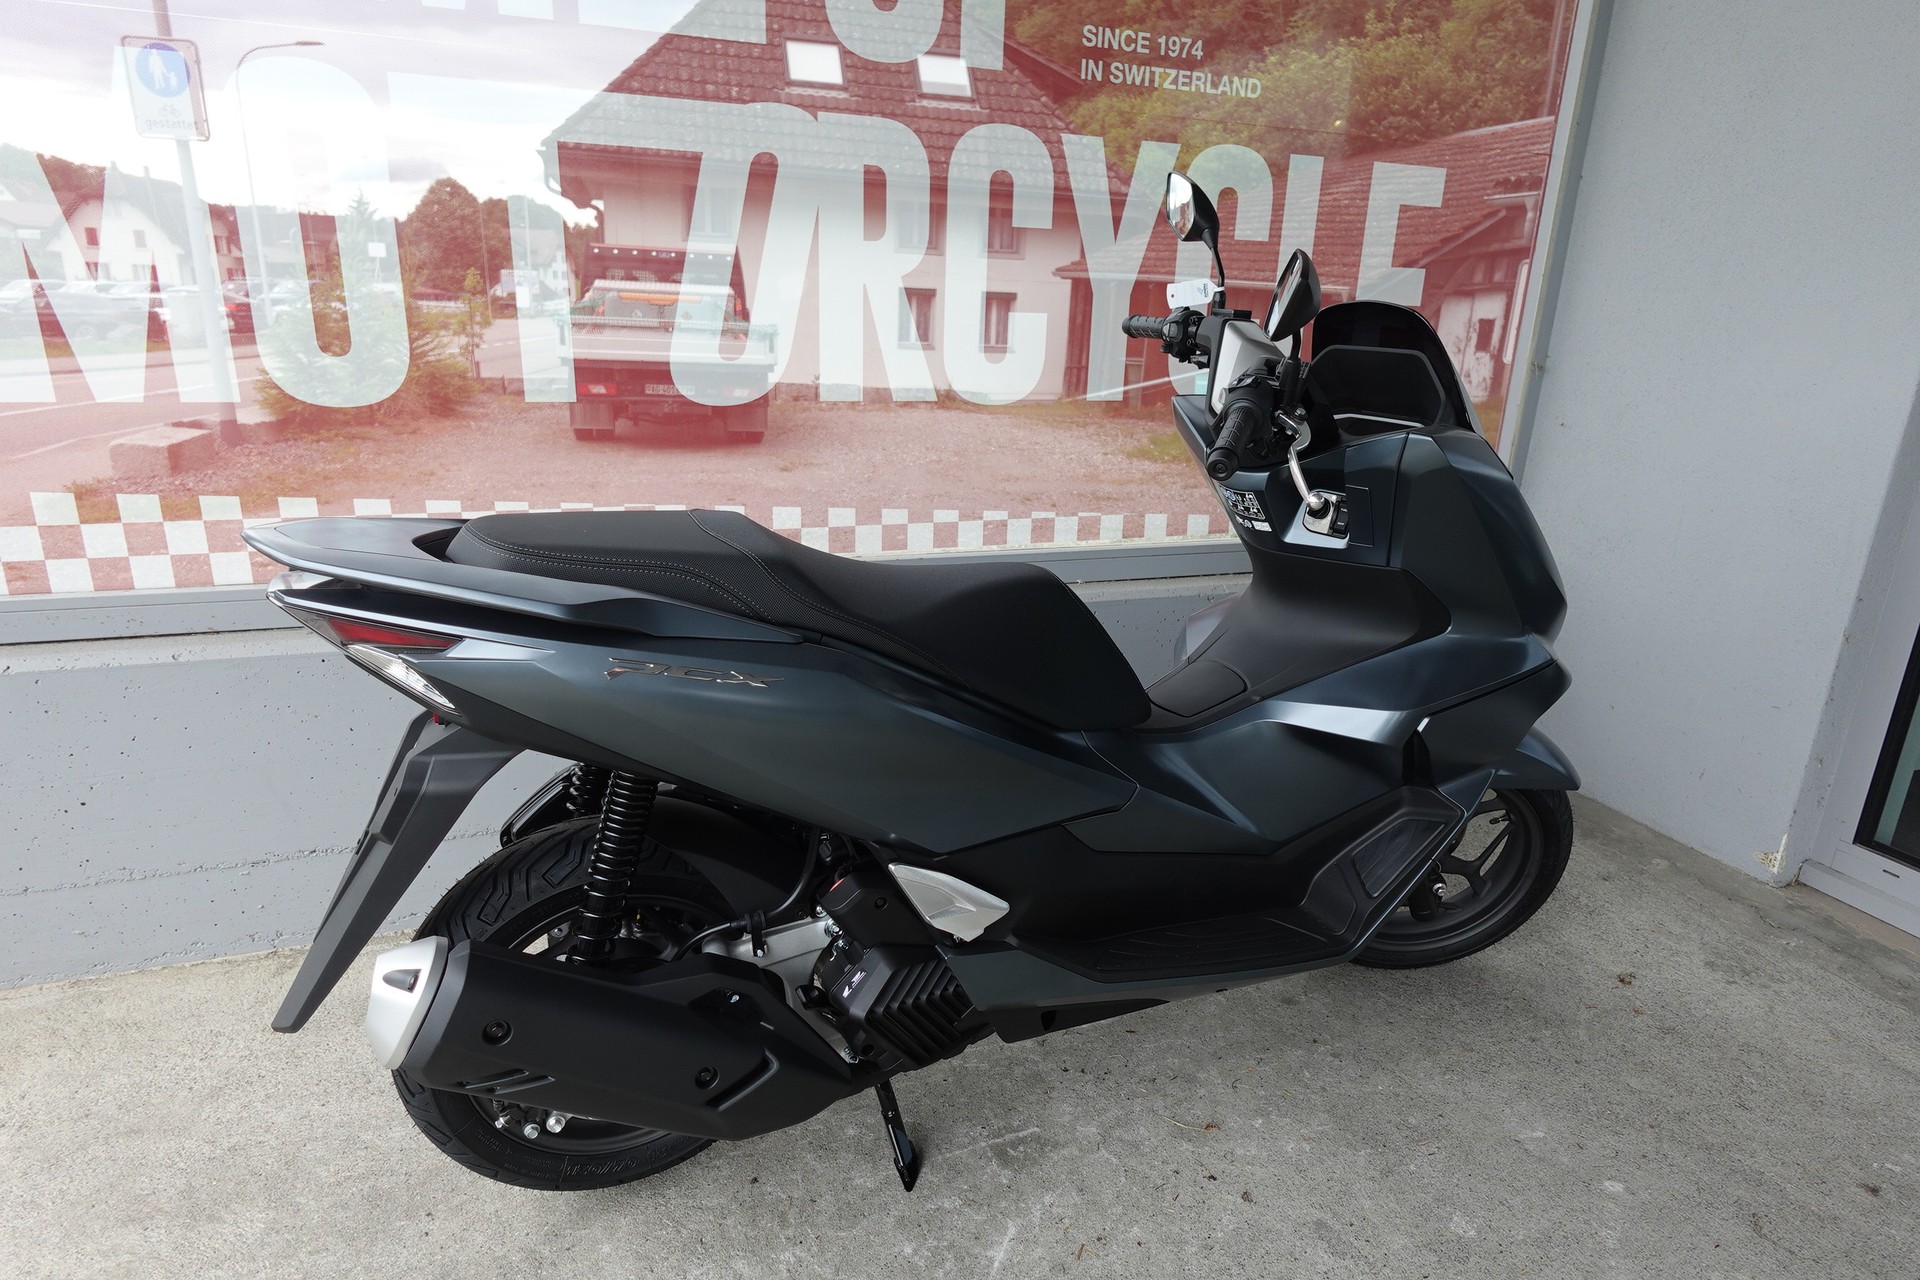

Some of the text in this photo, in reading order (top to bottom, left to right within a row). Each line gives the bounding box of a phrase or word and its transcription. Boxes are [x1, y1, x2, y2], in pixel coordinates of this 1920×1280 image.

[1082, 24, 1204, 60] SINCE 1974
[1080, 58, 1263, 99] IN SWITZERLAND
[604, 657, 785, 689] PCX
